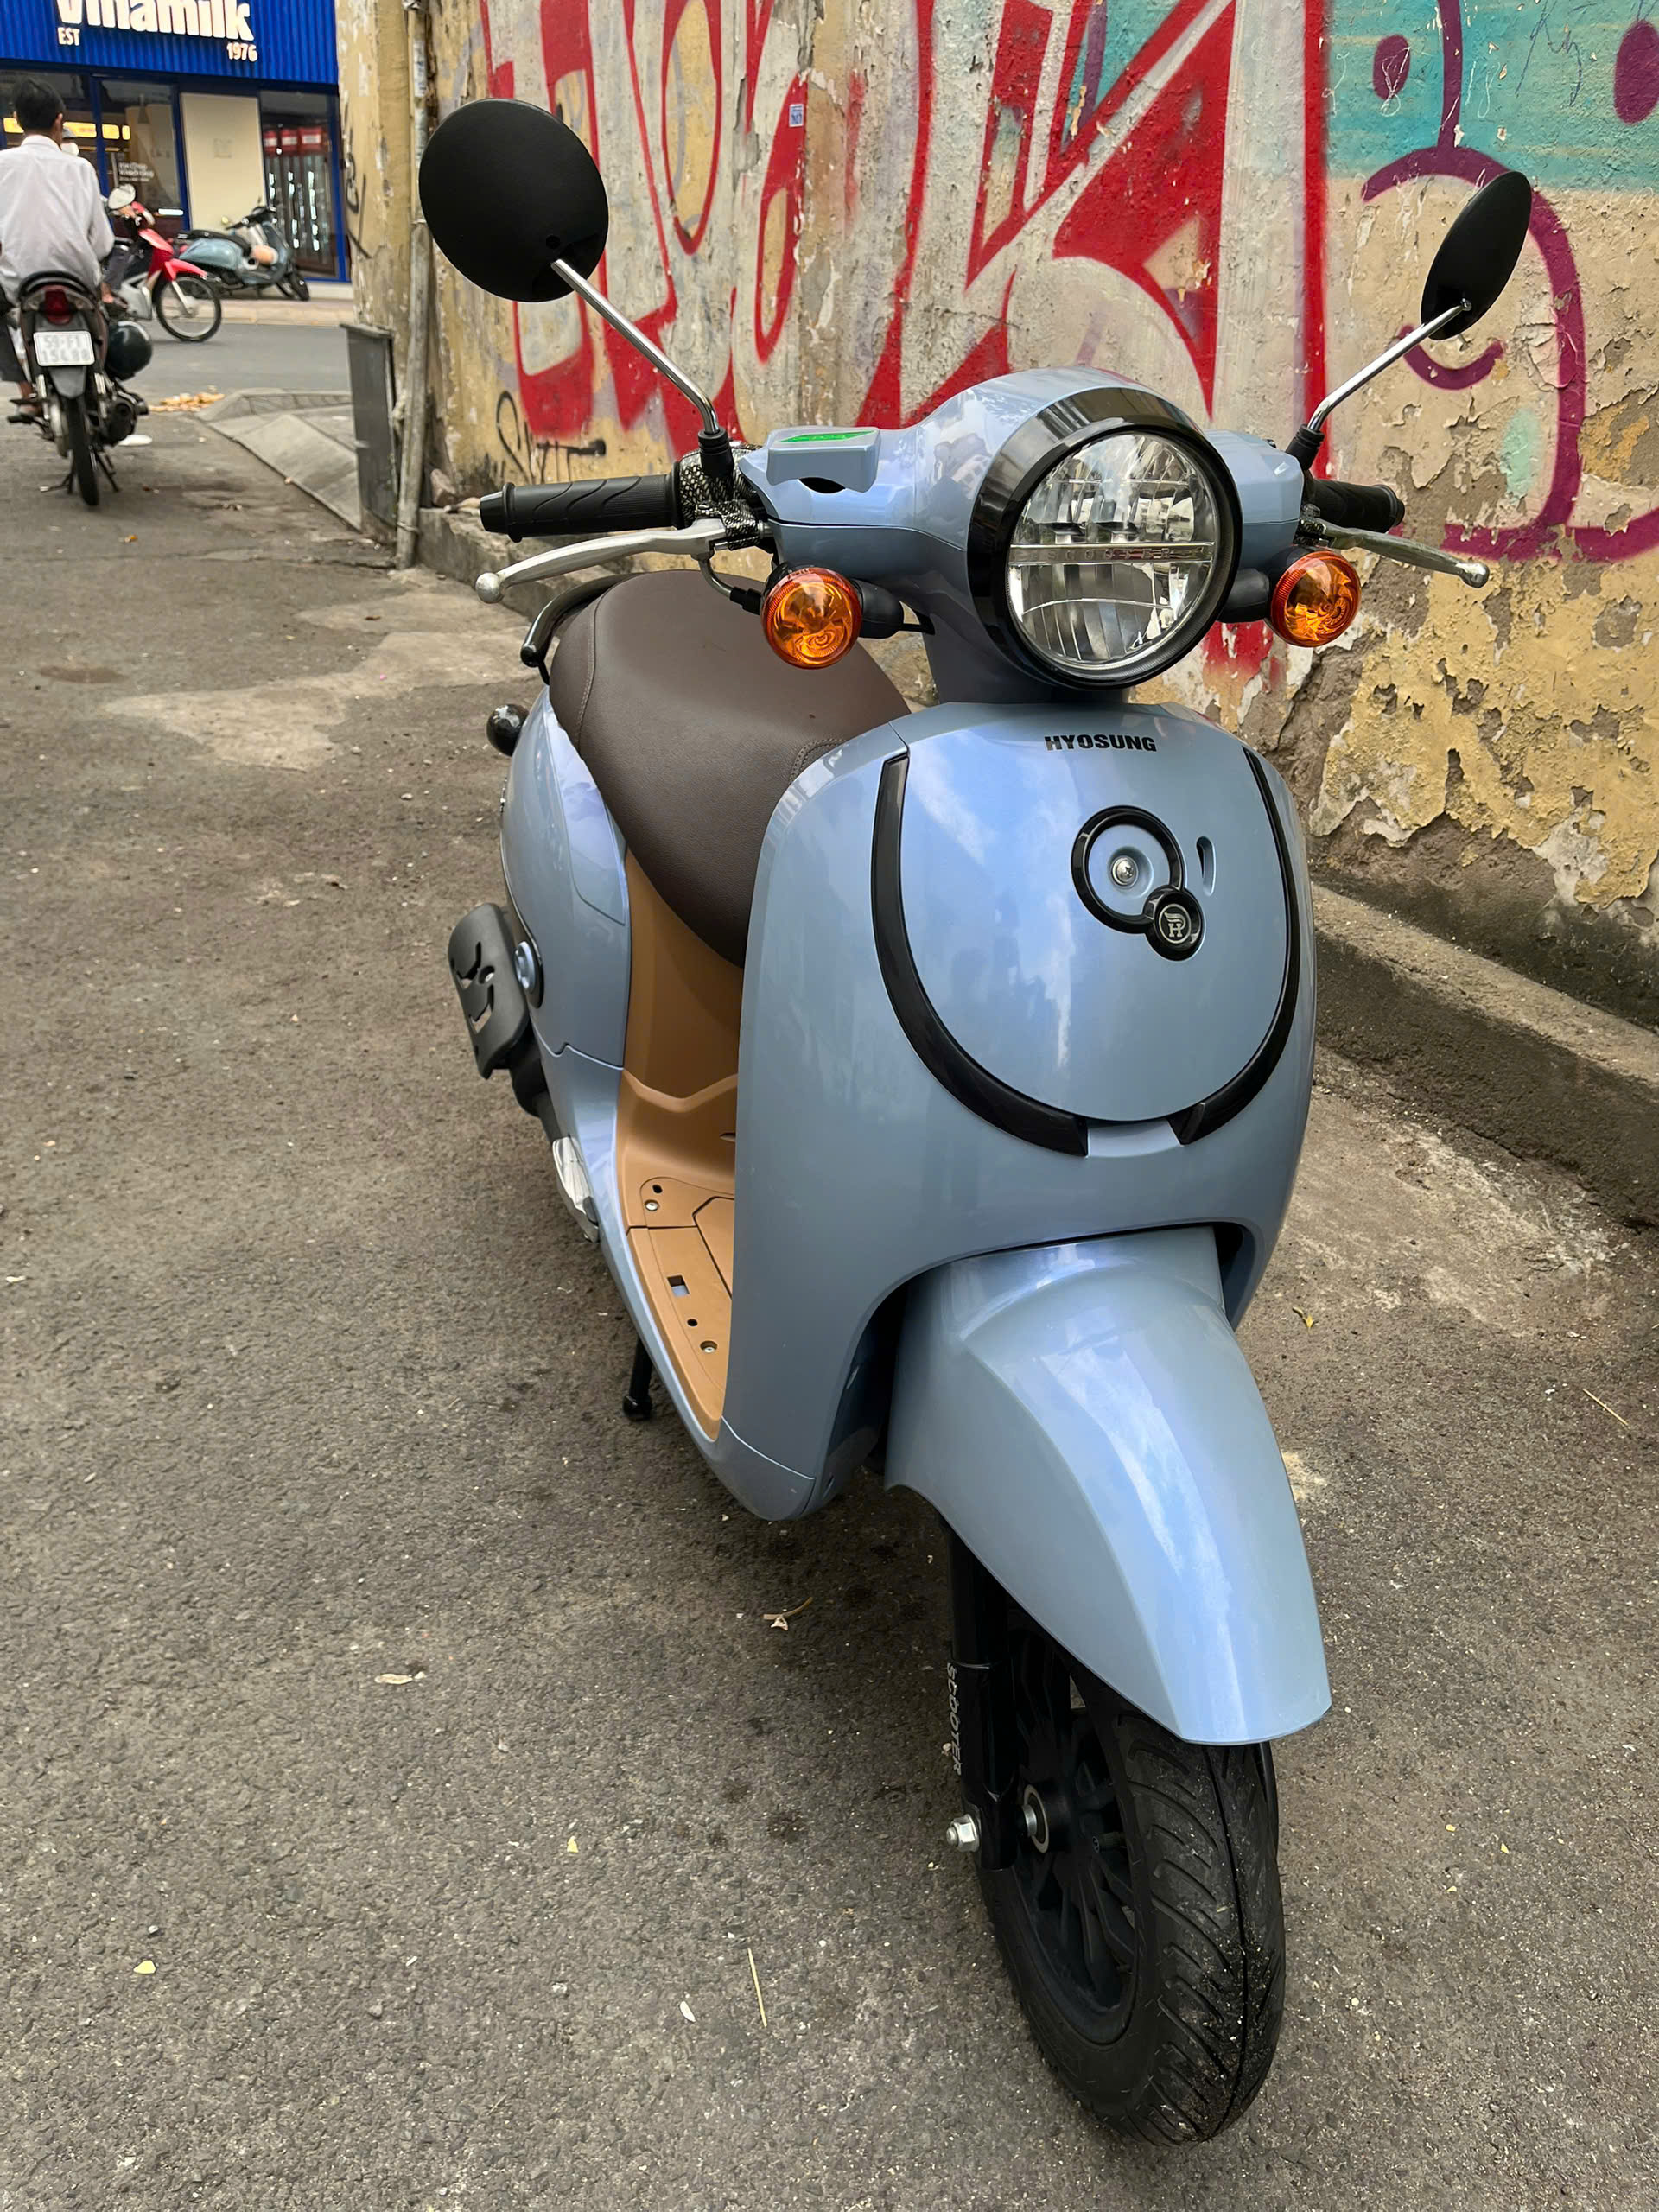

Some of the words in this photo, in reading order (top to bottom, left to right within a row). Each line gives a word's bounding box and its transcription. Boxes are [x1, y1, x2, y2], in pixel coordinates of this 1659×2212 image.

[57, 27, 80, 46] EST
[226, 41, 258, 62] 1976
[1044, 734, 1157, 752] HYOSUNG
[946, 1662, 962, 1776] SCOOTER
